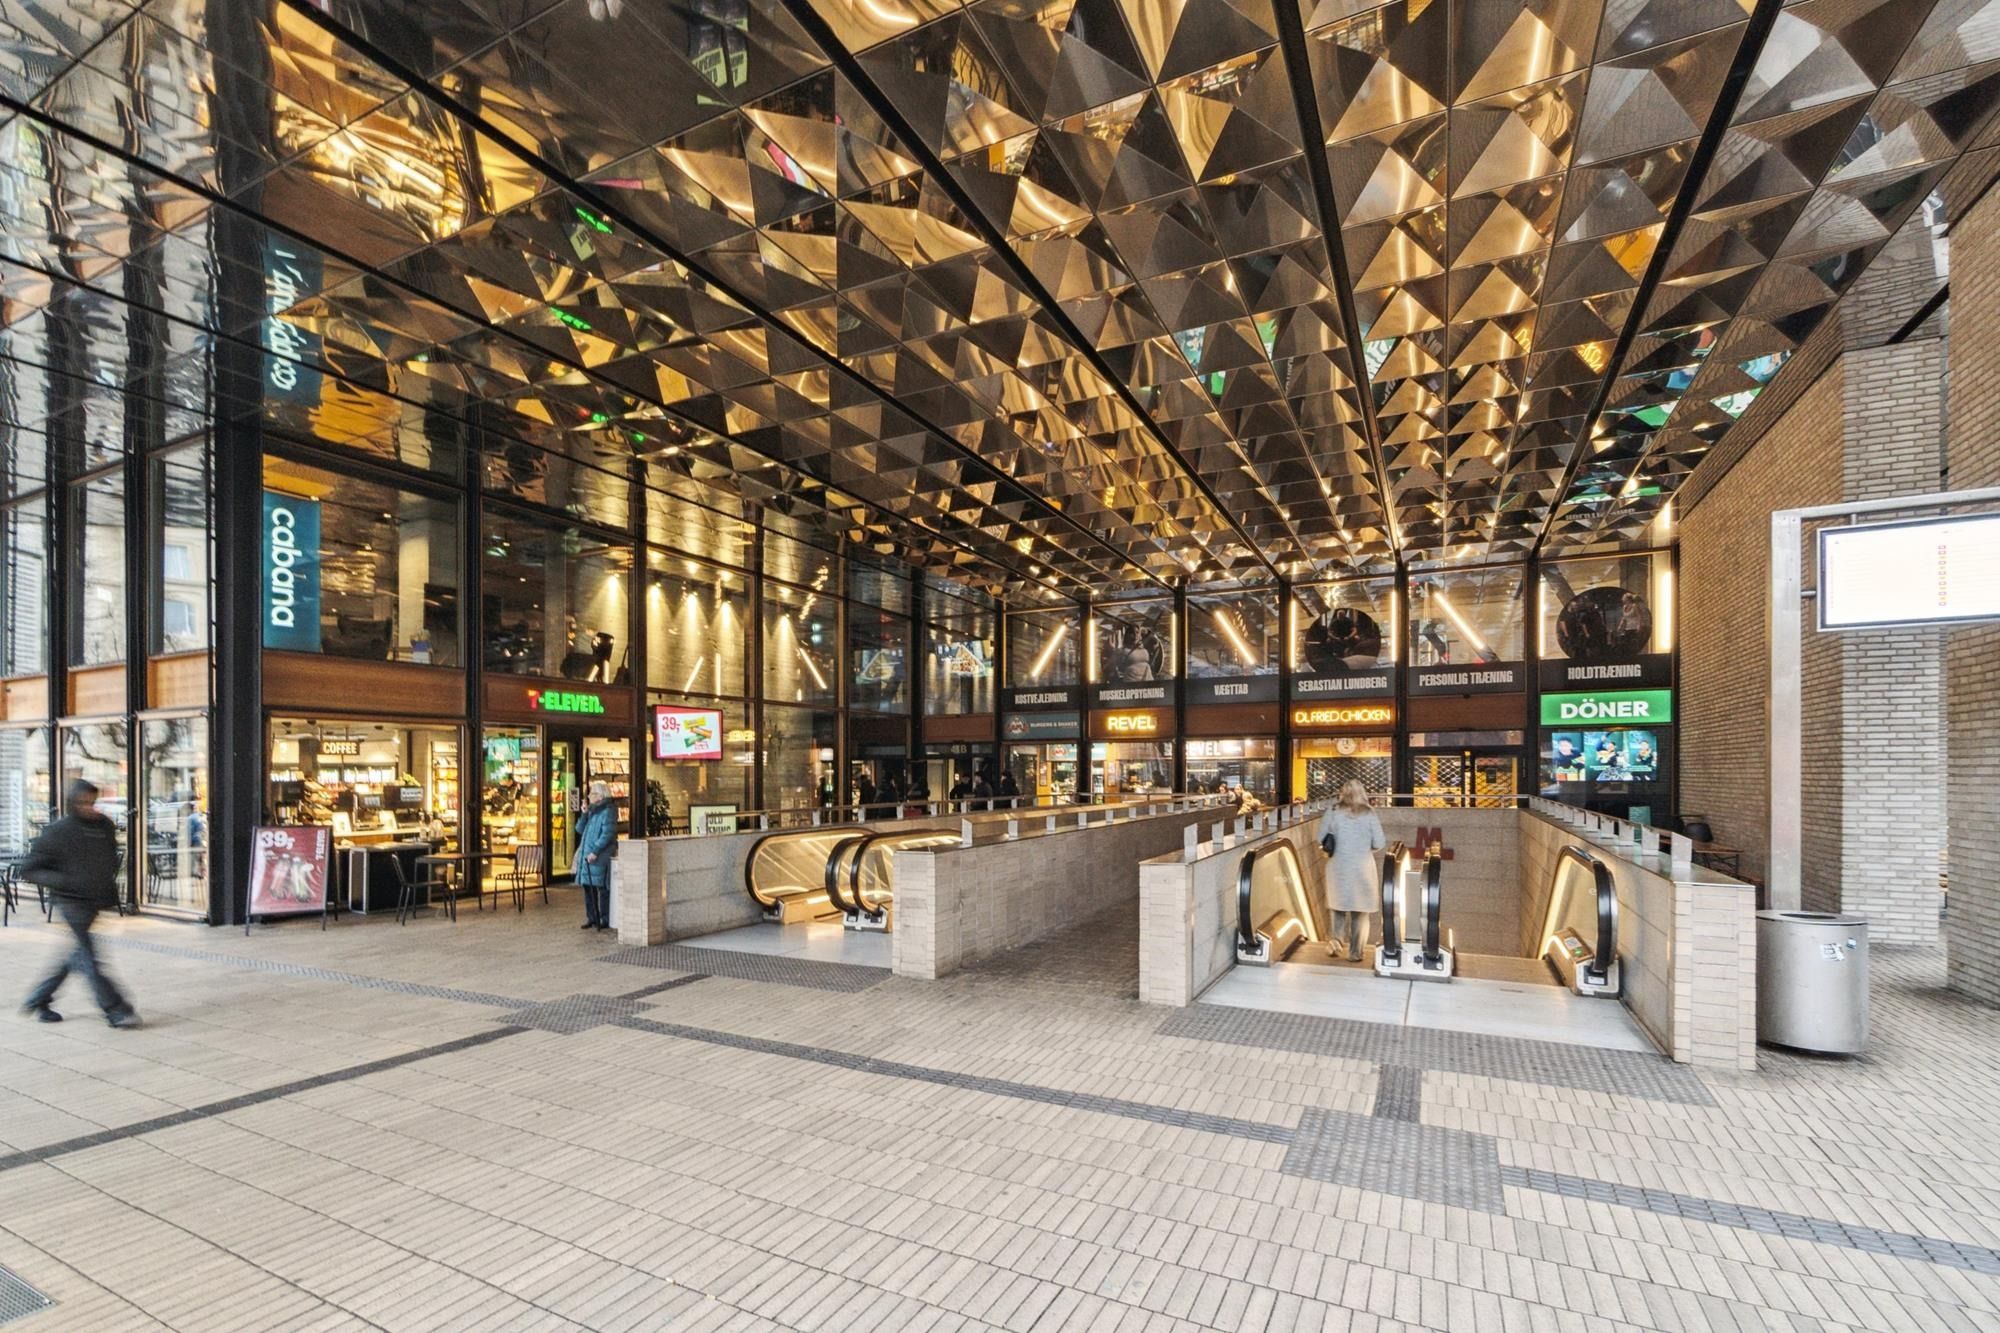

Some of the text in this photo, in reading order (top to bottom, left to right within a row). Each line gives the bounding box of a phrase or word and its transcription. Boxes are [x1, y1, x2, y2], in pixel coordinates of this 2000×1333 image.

[271, 507, 303, 628] cabana
[1419, 671, 1513, 686] PERSONLIG TRÆNING
[1567, 664, 1641, 680] HOLDTRÆNING
[1214, 684, 1248, 695] VÆGTTAB
[1298, 677, 1387, 691] SEBASTIAN LUNDBERG
[1015, 692, 1067, 704] KOSTVEJLEDNING
[1099, 688, 1164, 700] MUSKELOPBYGNING
[1561, 698, 1649, 718] DÖNER
[1311, 710, 1340, 722] FRIED
[1340, 709, 1391, 722] CHICKEN
[1107, 715, 1156, 731] REVEL
[323, 741, 357, 754] COFFEE
